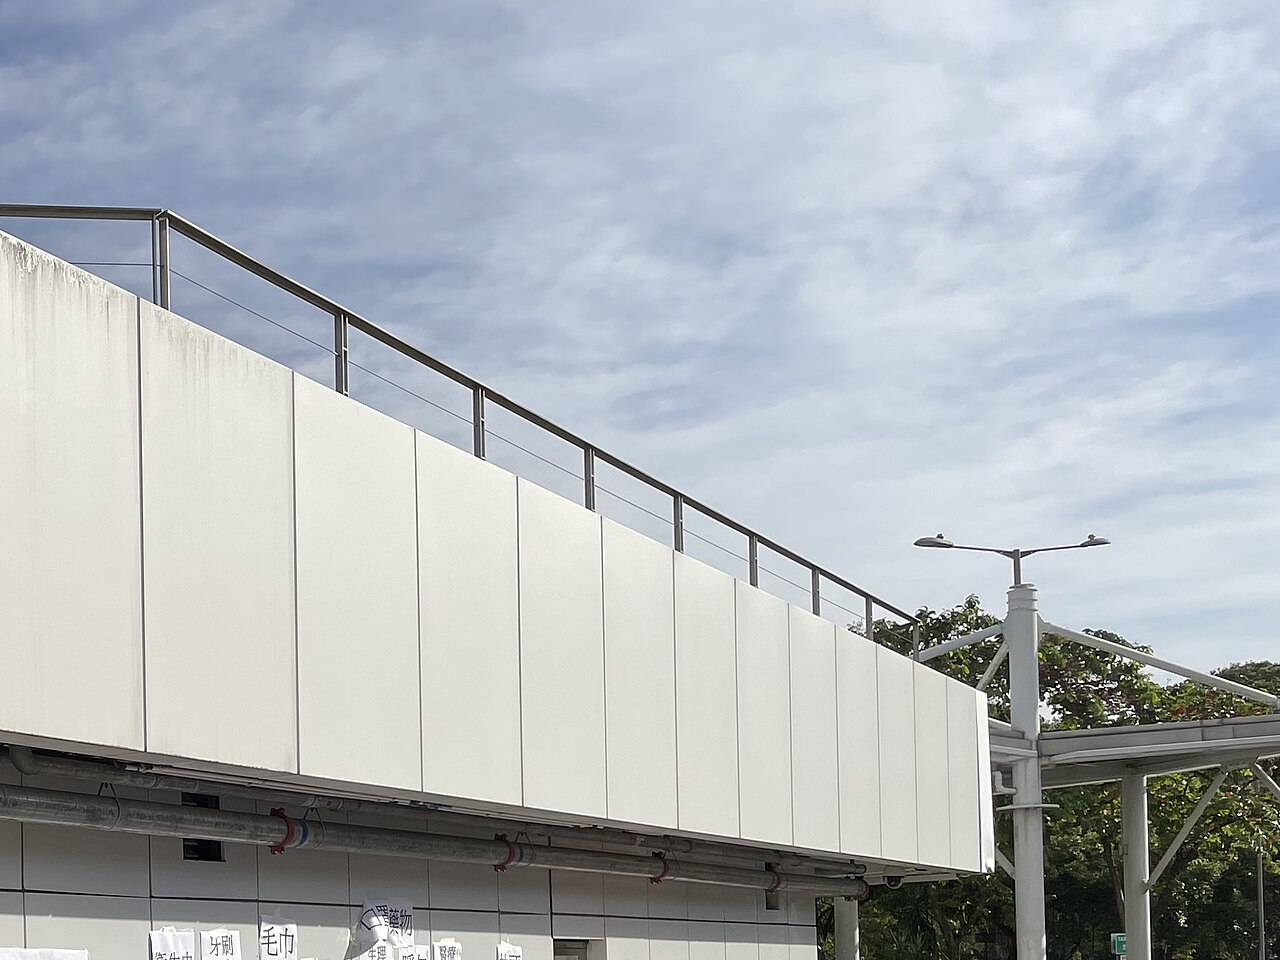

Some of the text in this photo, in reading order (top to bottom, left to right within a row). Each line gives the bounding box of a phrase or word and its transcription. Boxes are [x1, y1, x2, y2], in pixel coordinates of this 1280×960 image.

[389, 908, 413, 937] 藥物
[209, 935, 234, 957] 牙刷
[261, 926, 294, 958] 毛巾
